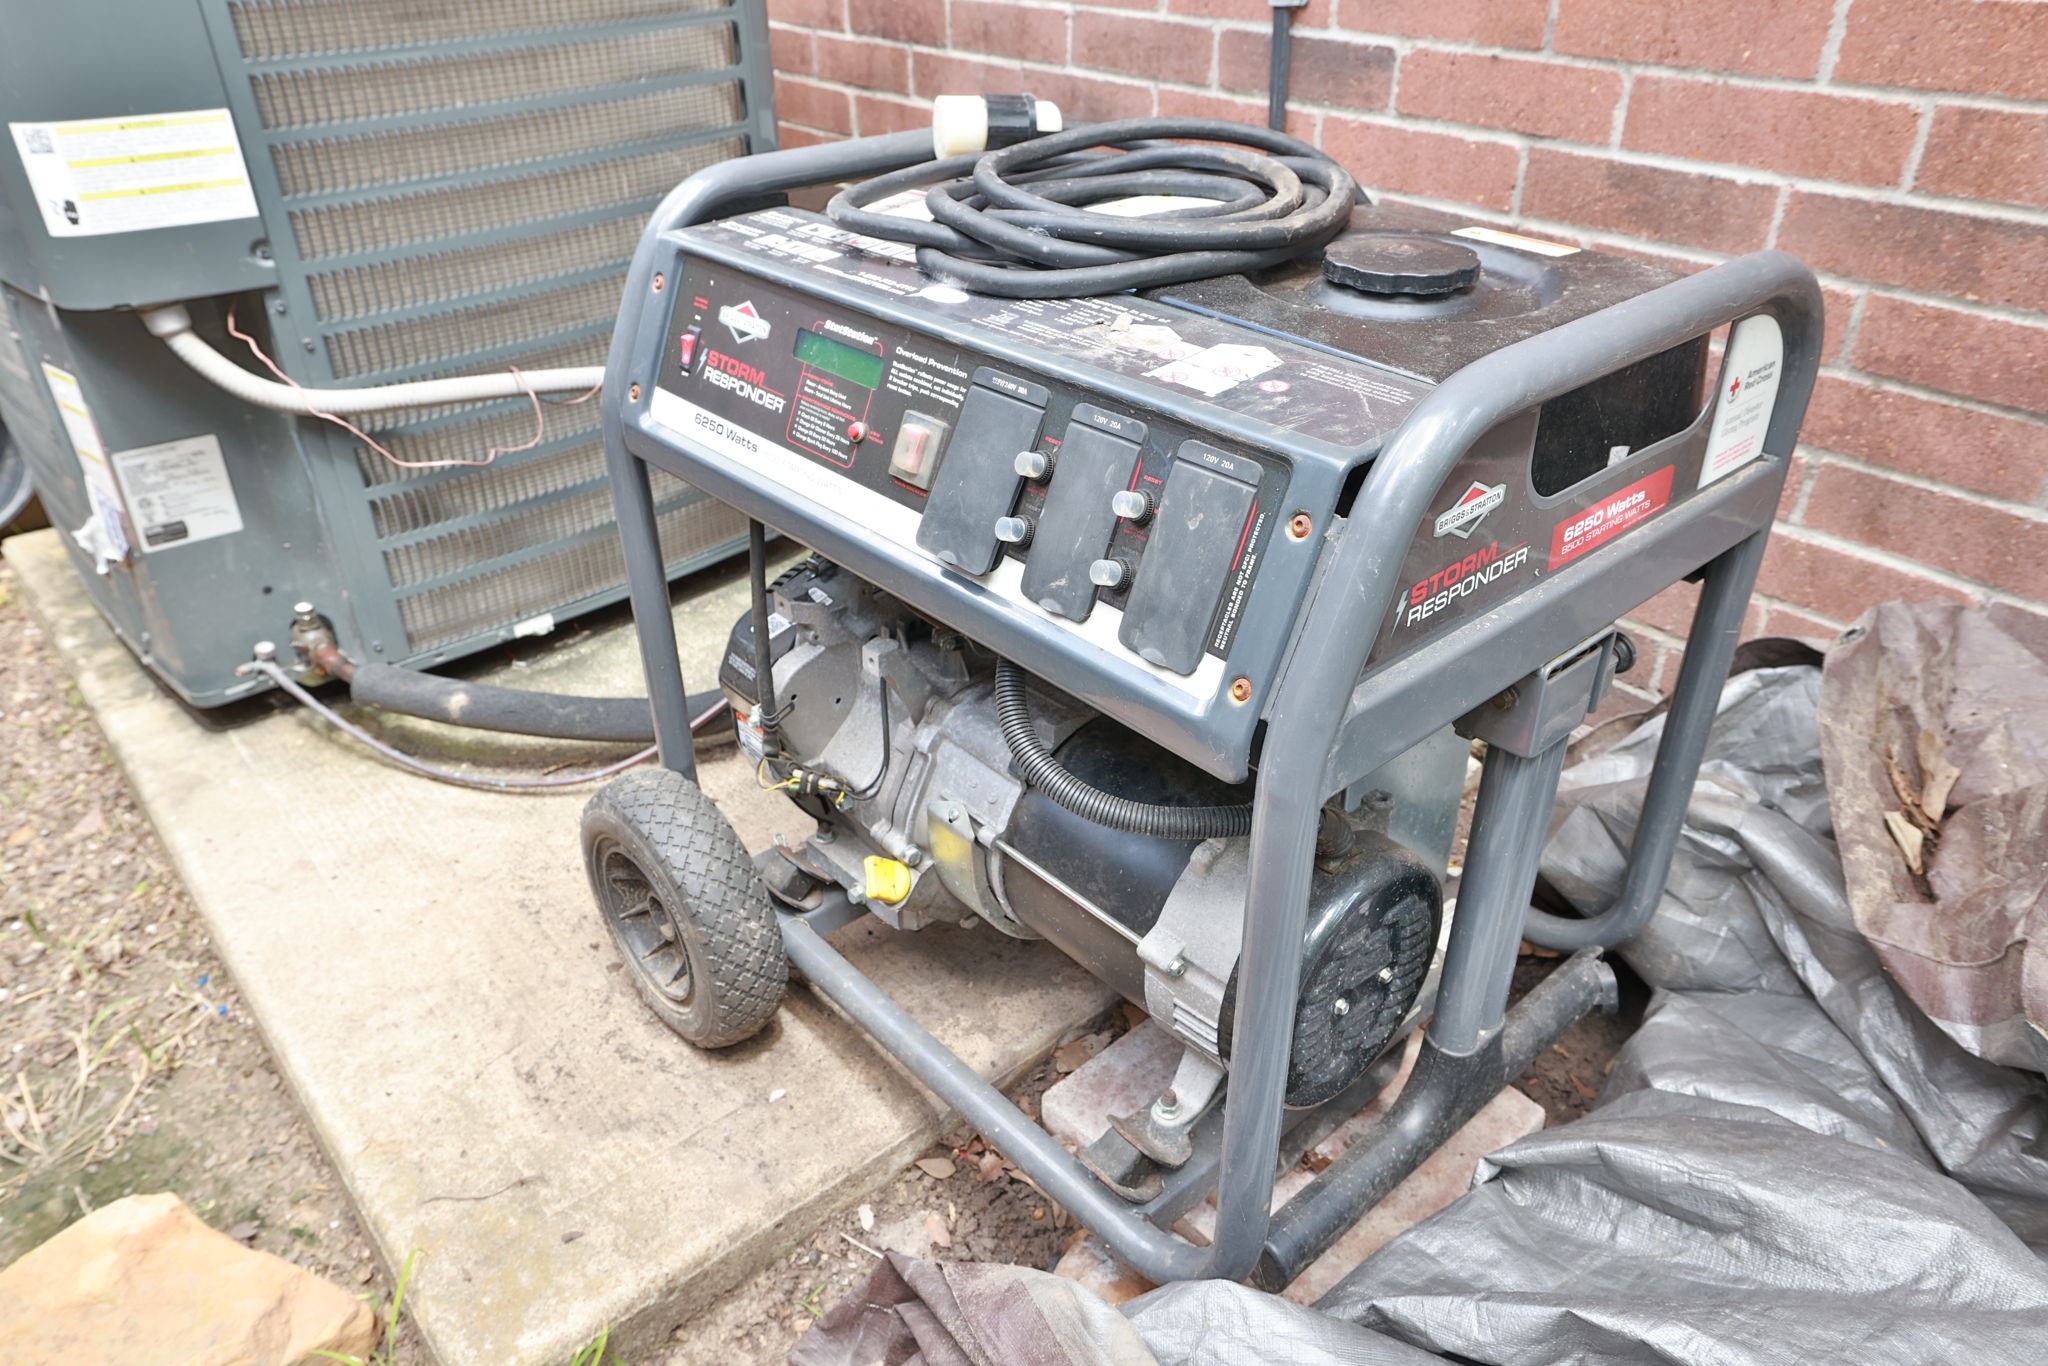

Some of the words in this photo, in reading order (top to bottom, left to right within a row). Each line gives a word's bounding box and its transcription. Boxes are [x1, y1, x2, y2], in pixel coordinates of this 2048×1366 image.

[707, 350, 766, 386] STORM
[896, 346, 928, 364] Overload
[928, 358, 968, 379] Prevention
[703, 366, 786, 413] RESPONDER
[694, 413, 724, 436] 6250
[726, 428, 758, 452] Watts
[1203, 453, 1219, 466] 120V
[1221, 460, 1234, 470] 20A
[1561, 536, 1584, 555] 8500
[1585, 515, 1624, 541] STARTING
[1624, 499, 1651, 520] WATTS
[1564, 510, 1604, 542] 6250
[1606, 490, 1646, 518] Watts
[1214, 602, 1234, 648] RECEPTACLES
[1236, 571, 1244, 586] NOT
[1248, 512, 1266, 552] PROTECTED.
[1406, 546, 1529, 627] RESPONDER
[1410, 540, 1498, 606] STORM
[1220, 620, 1234, 650] NEUTRAL
[1231, 590, 1244, 618] BONDED
[1241, 580, 1248, 589] TO
[1245, 553, 1258, 578] FRAME.
